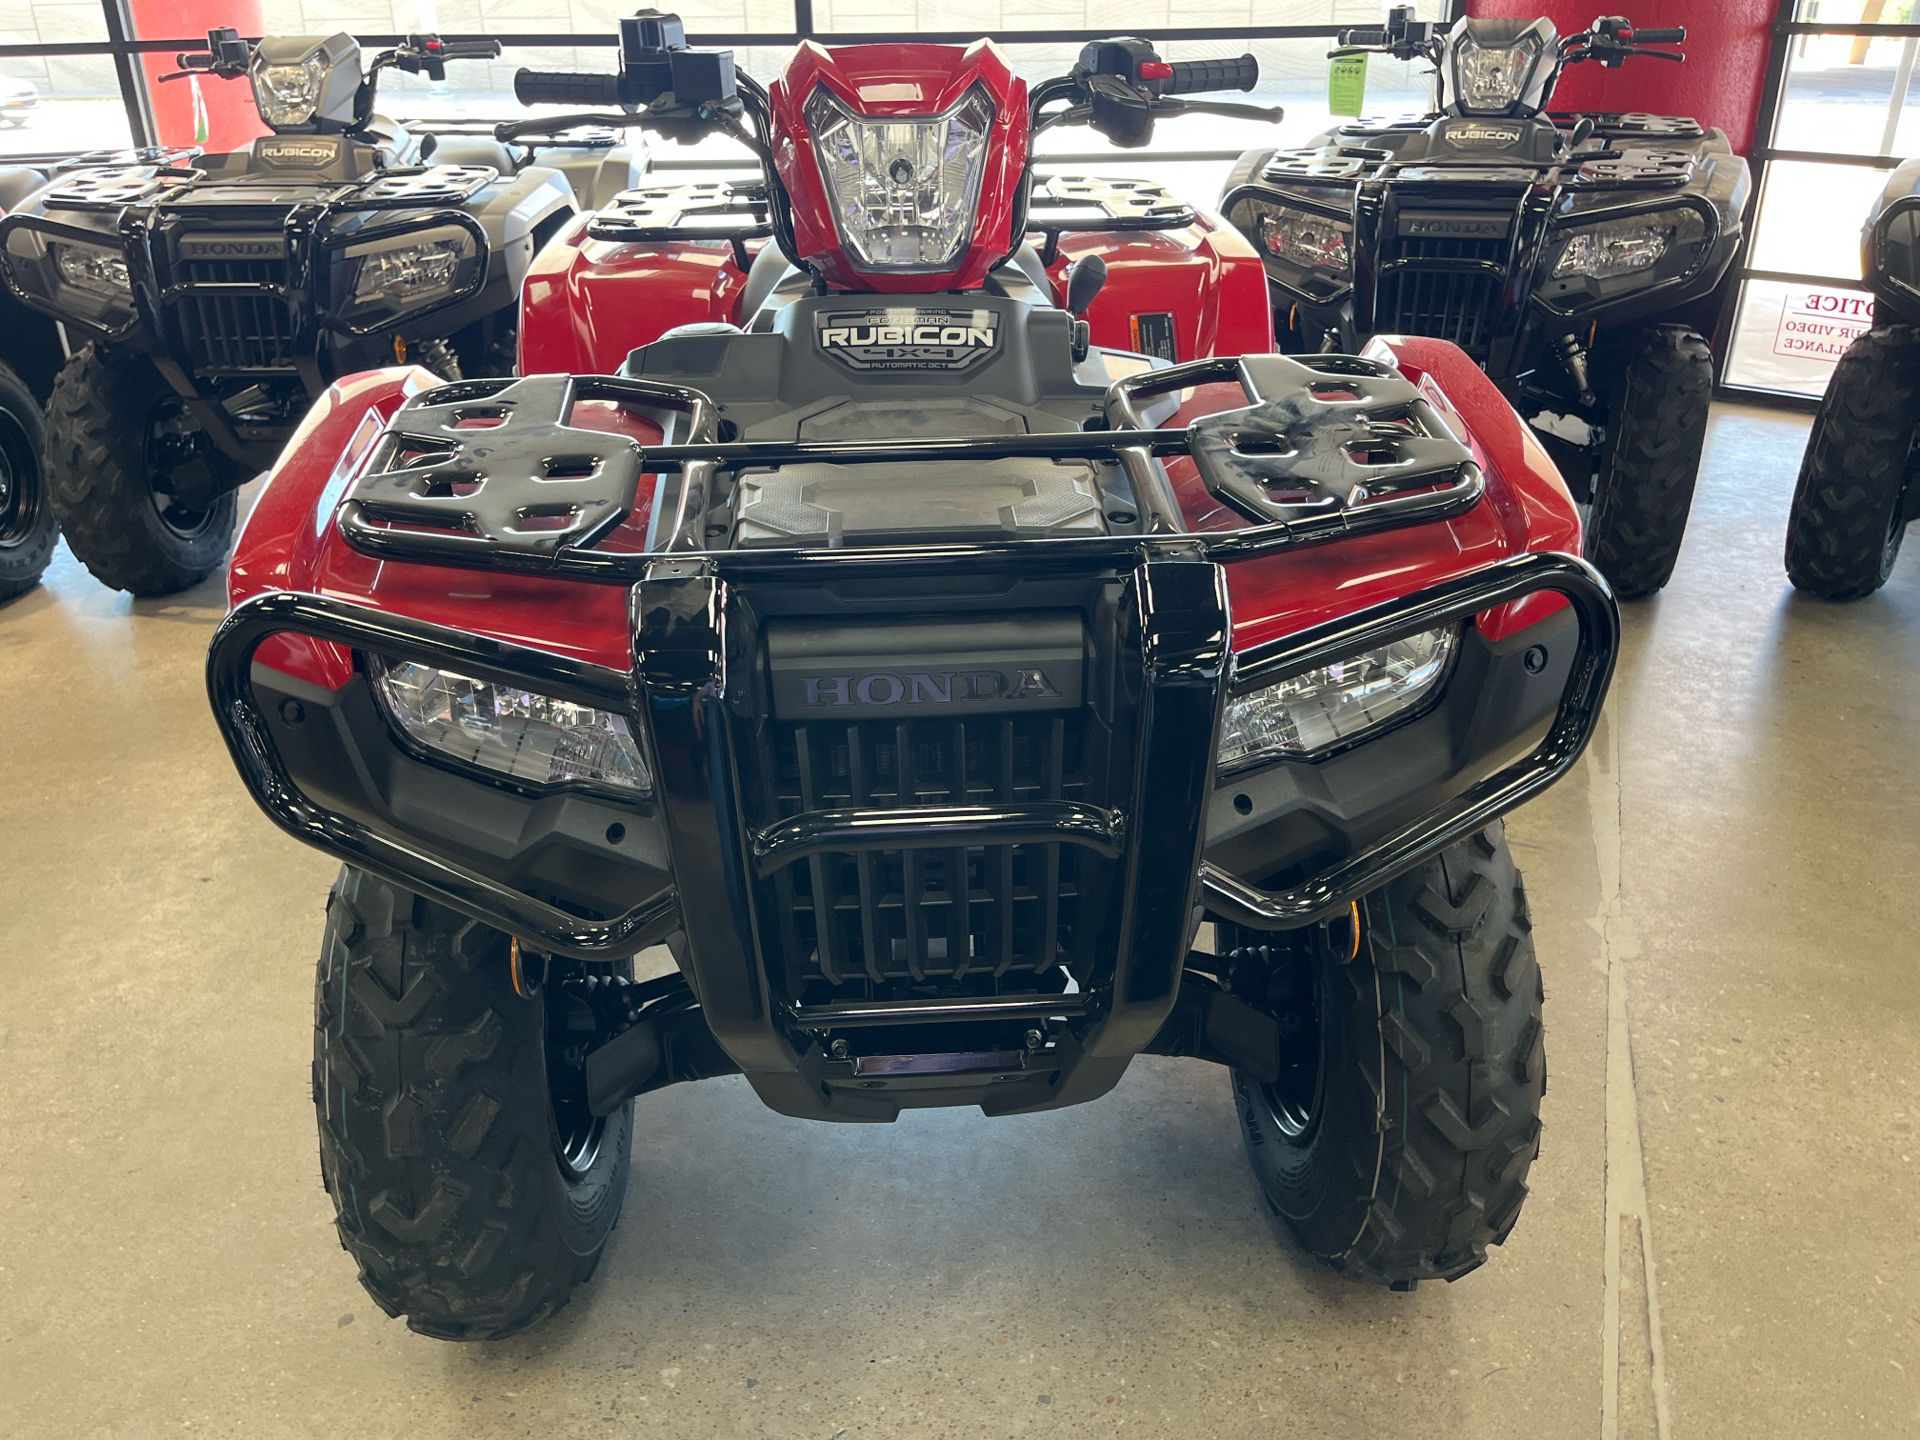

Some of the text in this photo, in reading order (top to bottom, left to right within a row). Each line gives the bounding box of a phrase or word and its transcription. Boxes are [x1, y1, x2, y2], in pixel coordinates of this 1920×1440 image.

[1445, 130, 1520, 142] RUBICON
[262, 148, 336, 158] RUBICON
[1409, 221, 1500, 235] HONDA
[190, 243, 280, 255] HONDA
[868, 316, 949, 325] FOREMAN
[822, 327, 994, 347] RUBICON
[801, 668, 1063, 707] HONDA
